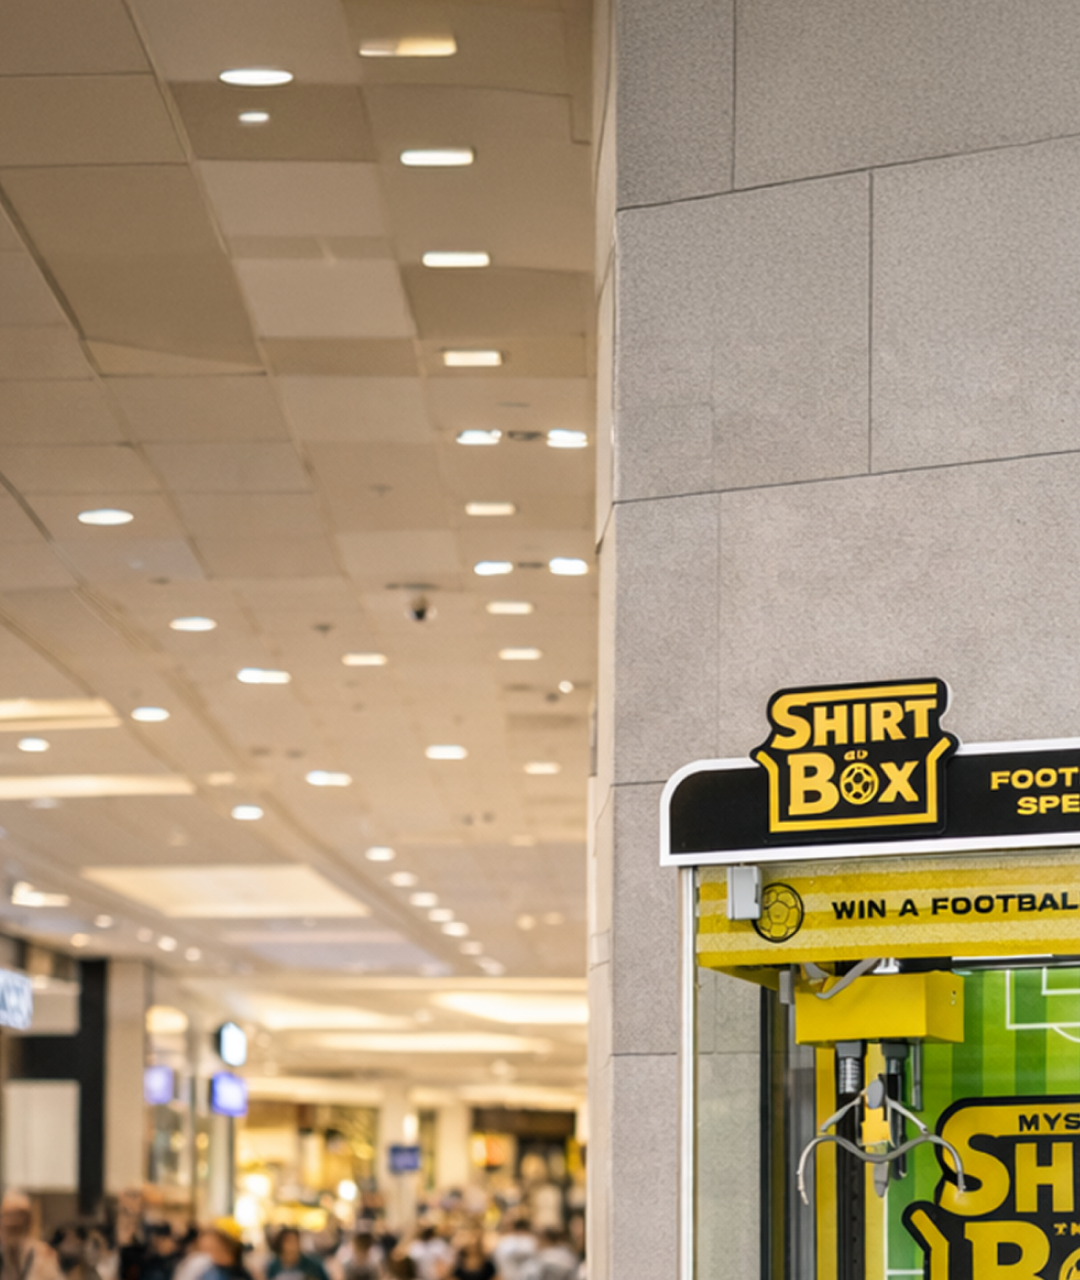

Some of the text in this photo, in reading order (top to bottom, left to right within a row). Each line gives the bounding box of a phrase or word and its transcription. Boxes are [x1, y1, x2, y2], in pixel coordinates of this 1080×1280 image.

[770, 684, 938, 750] SHIRT
[787, 752, 920, 816] BOX
[832, 899, 887, 920] WIN
[898, 898, 919, 917] A
